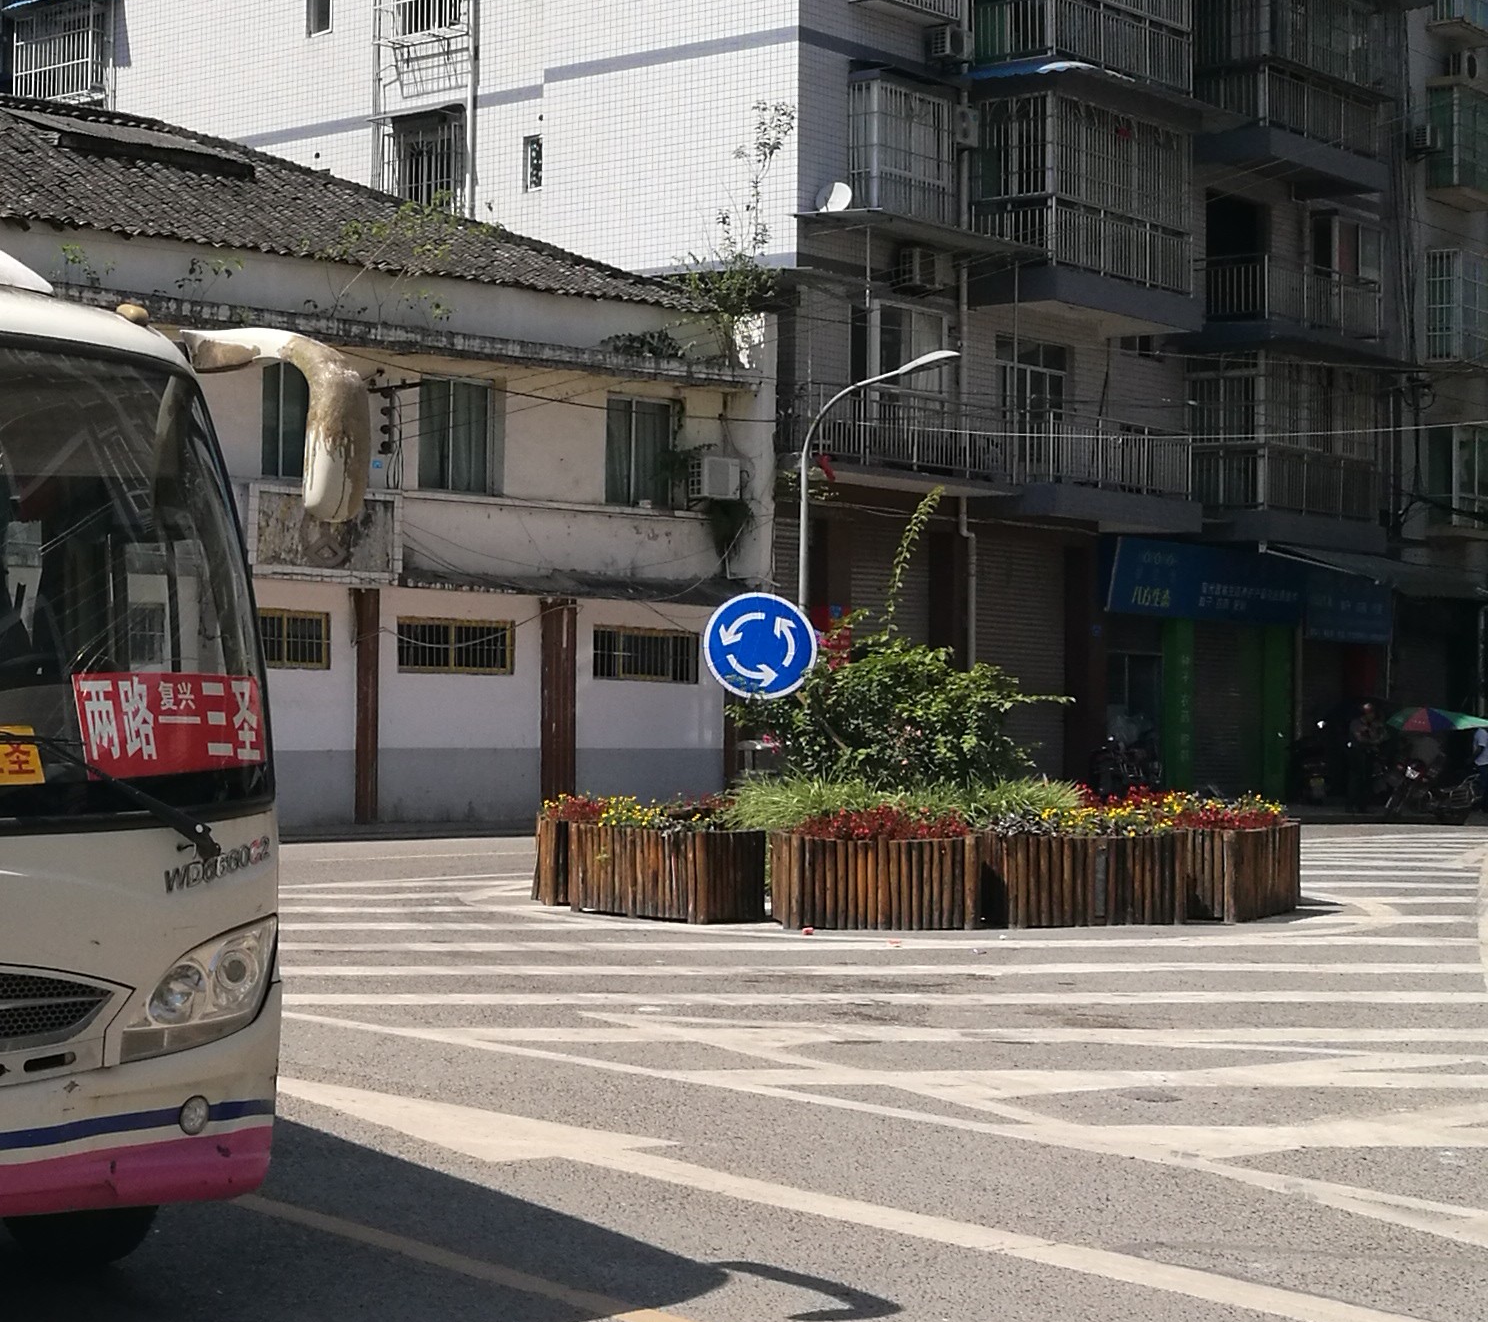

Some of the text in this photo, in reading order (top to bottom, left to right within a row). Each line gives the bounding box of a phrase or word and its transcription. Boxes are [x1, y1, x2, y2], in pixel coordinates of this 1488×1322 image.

[79, 676, 261, 760] 两路 复兴 三圣
